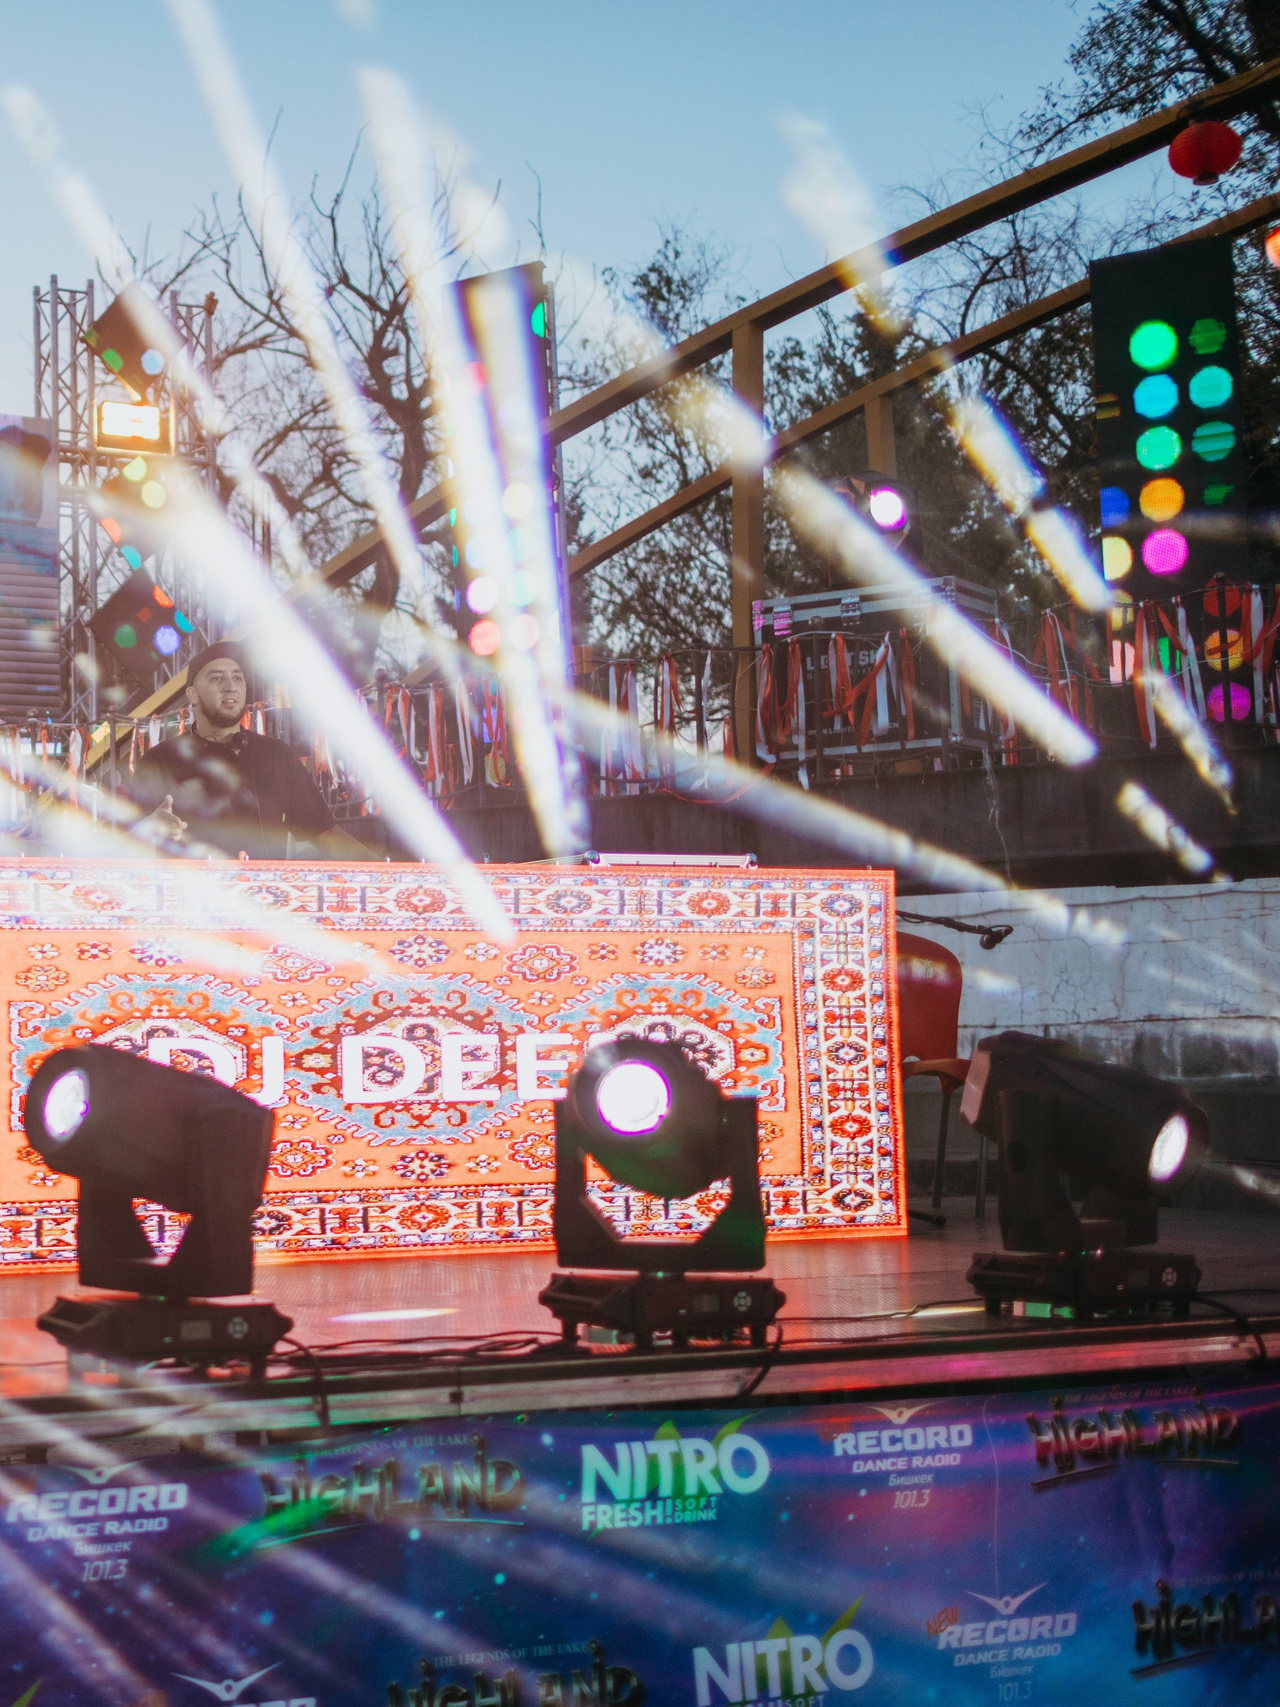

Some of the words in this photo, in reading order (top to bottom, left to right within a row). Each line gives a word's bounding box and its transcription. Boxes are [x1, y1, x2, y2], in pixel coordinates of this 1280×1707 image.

[341, 1030, 625, 1105] DEE
[833, 1424, 973, 1456] RECORD
[1026, 1403, 1239, 1473] HIGHLAND
[581, 1433, 770, 1504] NITRO
[852, 1457, 908, 1474] DANCE
[912, 1453, 961, 1468] RADIO
[260, 1455, 523, 1522] HIGHLAND
[889, 1474, 934, 1486] Бишкек
[6, 1482, 188, 1523] RECORD
[675, 1497, 718, 1511] SOFT
[893, 1489, 931, 1508] 101.3
[582, 1499, 673, 1531] FRESH!
[674, 1506, 718, 1524] DRINK
[27, 1522, 100, 1542] DANCE
[104, 1517, 169, 1535] RADIO
[74, 1541, 131, 1556] Бишкек
[82, 1558, 129, 1582] 101.3
[926, 1604, 959, 1640] NEW
[937, 1612, 1078, 1650] RECORD
[434, 1656, 455, 1669] THE
[459, 1649, 510, 1665] LEGENDS
[513, 1647, 528, 1659] OF
[532, 1645, 554, 1657] THE
[558, 1642, 588, 1654] LAKE
[692, 1628, 874, 1706] NITRO
[953, 1649, 1010, 1667] DANCE
[1012, 1643, 1063, 1660] RADIO
[998, 1681, 1032, 1701] 101.3
